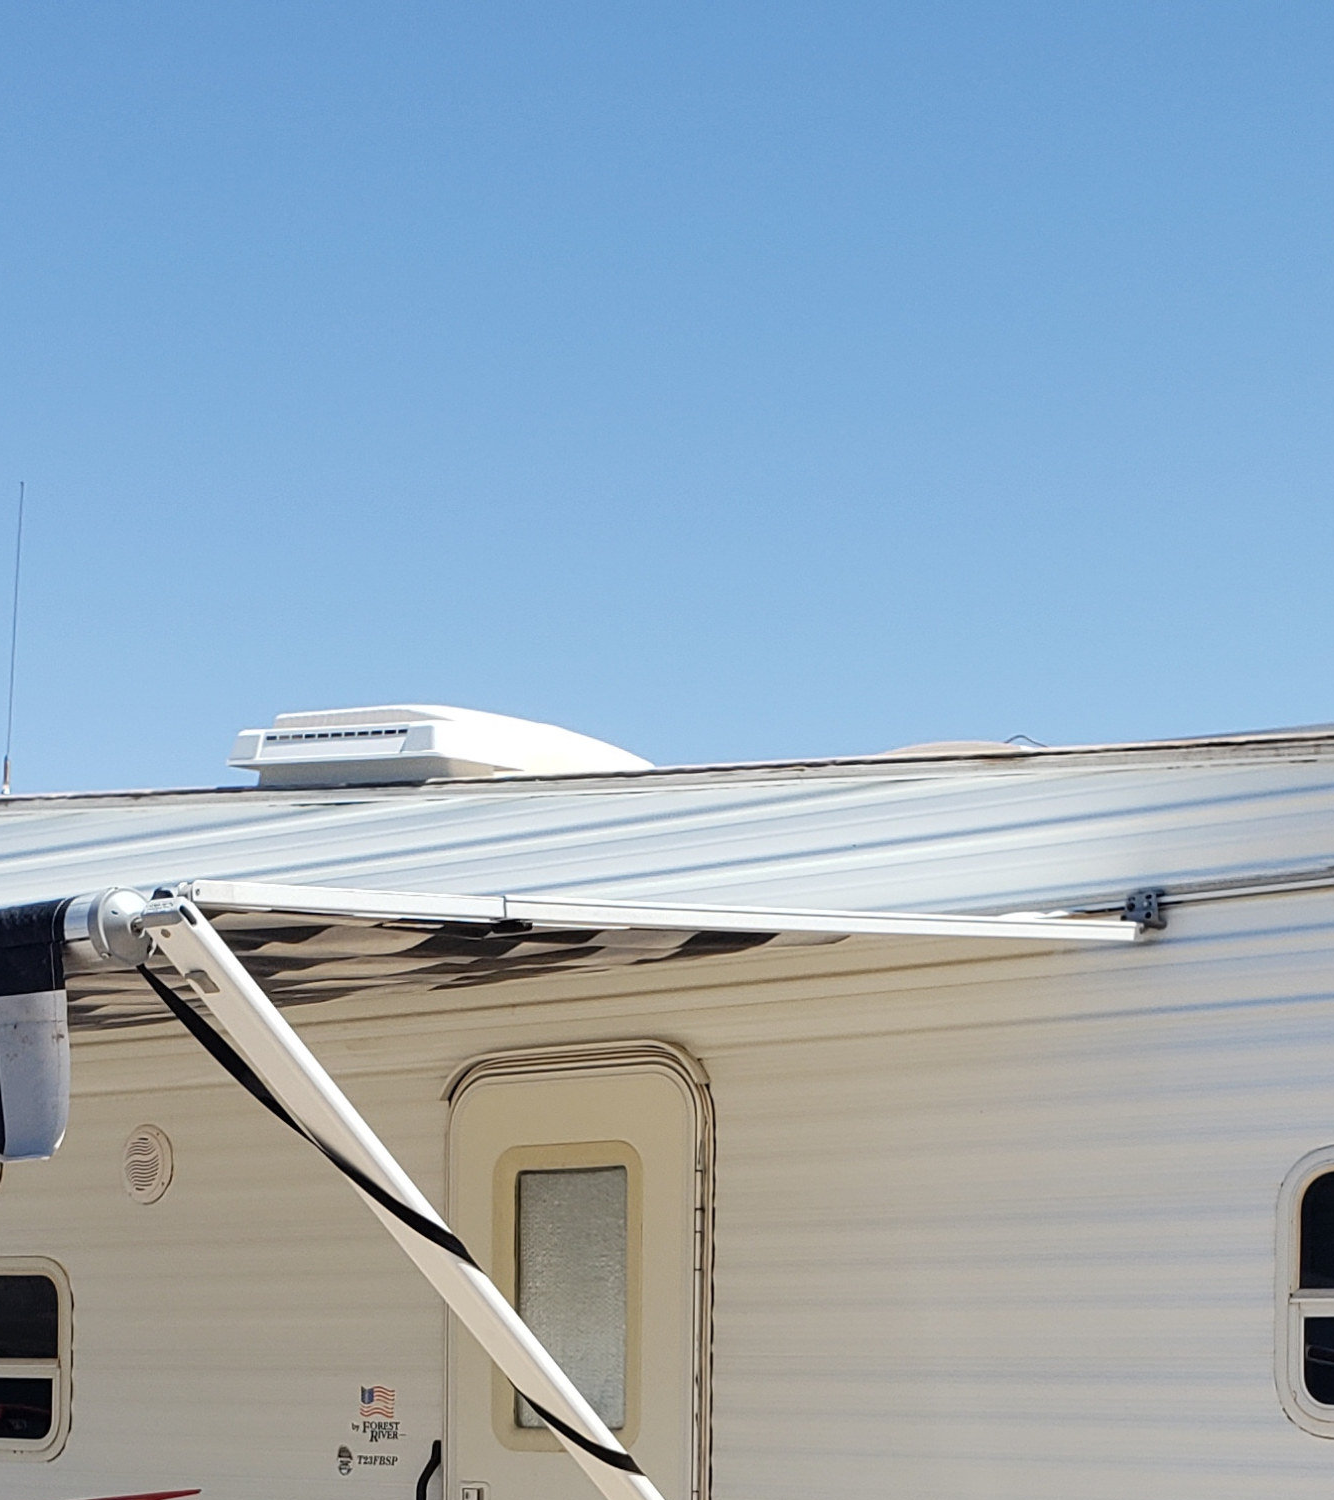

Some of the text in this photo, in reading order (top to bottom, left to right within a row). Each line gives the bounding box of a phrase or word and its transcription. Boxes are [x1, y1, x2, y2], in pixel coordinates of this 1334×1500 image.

[351, 1421, 400, 1433] by FOREST
[369, 1431, 398, 1442] RIVER
[357, 1455, 398, 1466] T23FBSP
